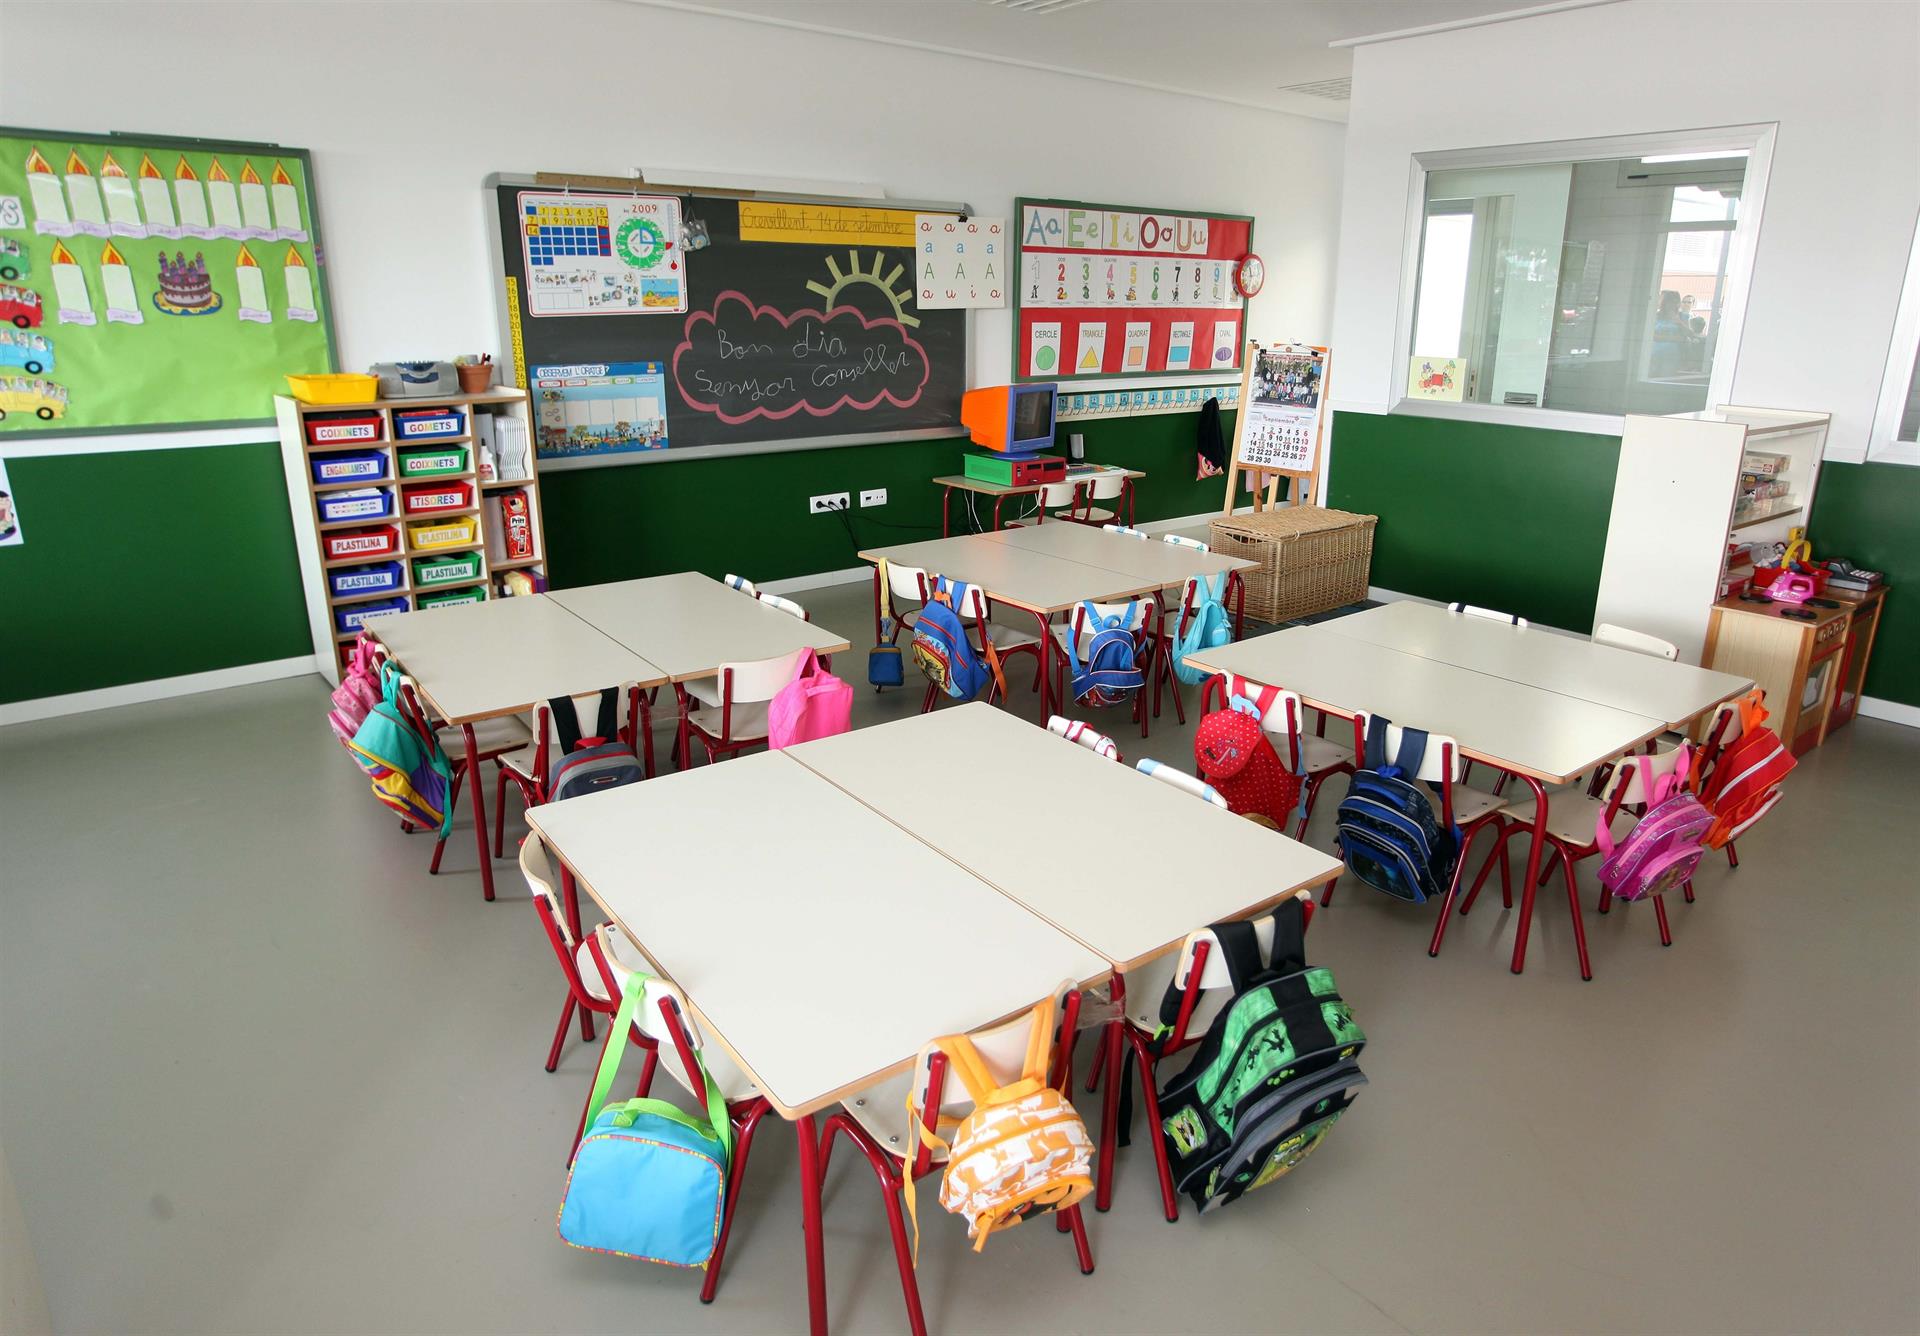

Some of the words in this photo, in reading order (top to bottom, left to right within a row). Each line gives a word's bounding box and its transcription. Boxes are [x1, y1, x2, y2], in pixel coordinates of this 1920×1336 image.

[632, 204, 657, 214] 2009
[817, 211, 831, 232] 14
[834, 209, 850, 232] de
[920, 222, 932, 232] a
[944, 223, 955, 232] a
[967, 224, 978, 233] a
[990, 225, 1001, 234] a
[925, 242, 933, 253] a
[956, 243, 964, 253] a
[986, 243, 994, 254] a
[924, 262, 934, 279] A
[955, 263, 966, 279] A
[985, 263, 995, 279] A
[1058, 263, 1065, 281] 2
[1082, 263, 1090, 281] 3
[1106, 264, 1114, 281] 4
[1130, 266, 1137, 284] 5
[1153, 266, 1159, 283] 6
[1175, 266, 1181, 282] 7
[1195, 267, 1201, 283] 8
[1214, 267, 1220, 282] 9
[507, 287, 516, 295] 16
[922, 290, 934, 299] a
[946, 290, 956, 299] u
[970, 284, 976, 298] i
[990, 289, 1001, 298] a
[509, 304, 518, 312] 18
[1034, 330, 1057, 338] CERCLE
[1082, 329, 1104, 338] TRIANGLE
[718, 328, 773, 359] Bon
[792, 322, 846, 358] dia
[695, 369, 796, 400] Senyor
[812, 344, 911, 387] Conseller
[320, 427, 369, 438] COIXINETS
[410, 421, 452, 433] GOMETS
[410, 459, 455, 469] COIXINETS
[414, 495, 455, 506] TISORES
[421, 531, 464, 544] PLASTILINA
[336, 538, 381, 551] PLASTILINA
[426, 566, 468, 579] PLASTILINA
[341, 575, 386, 588] PLASTILINA
